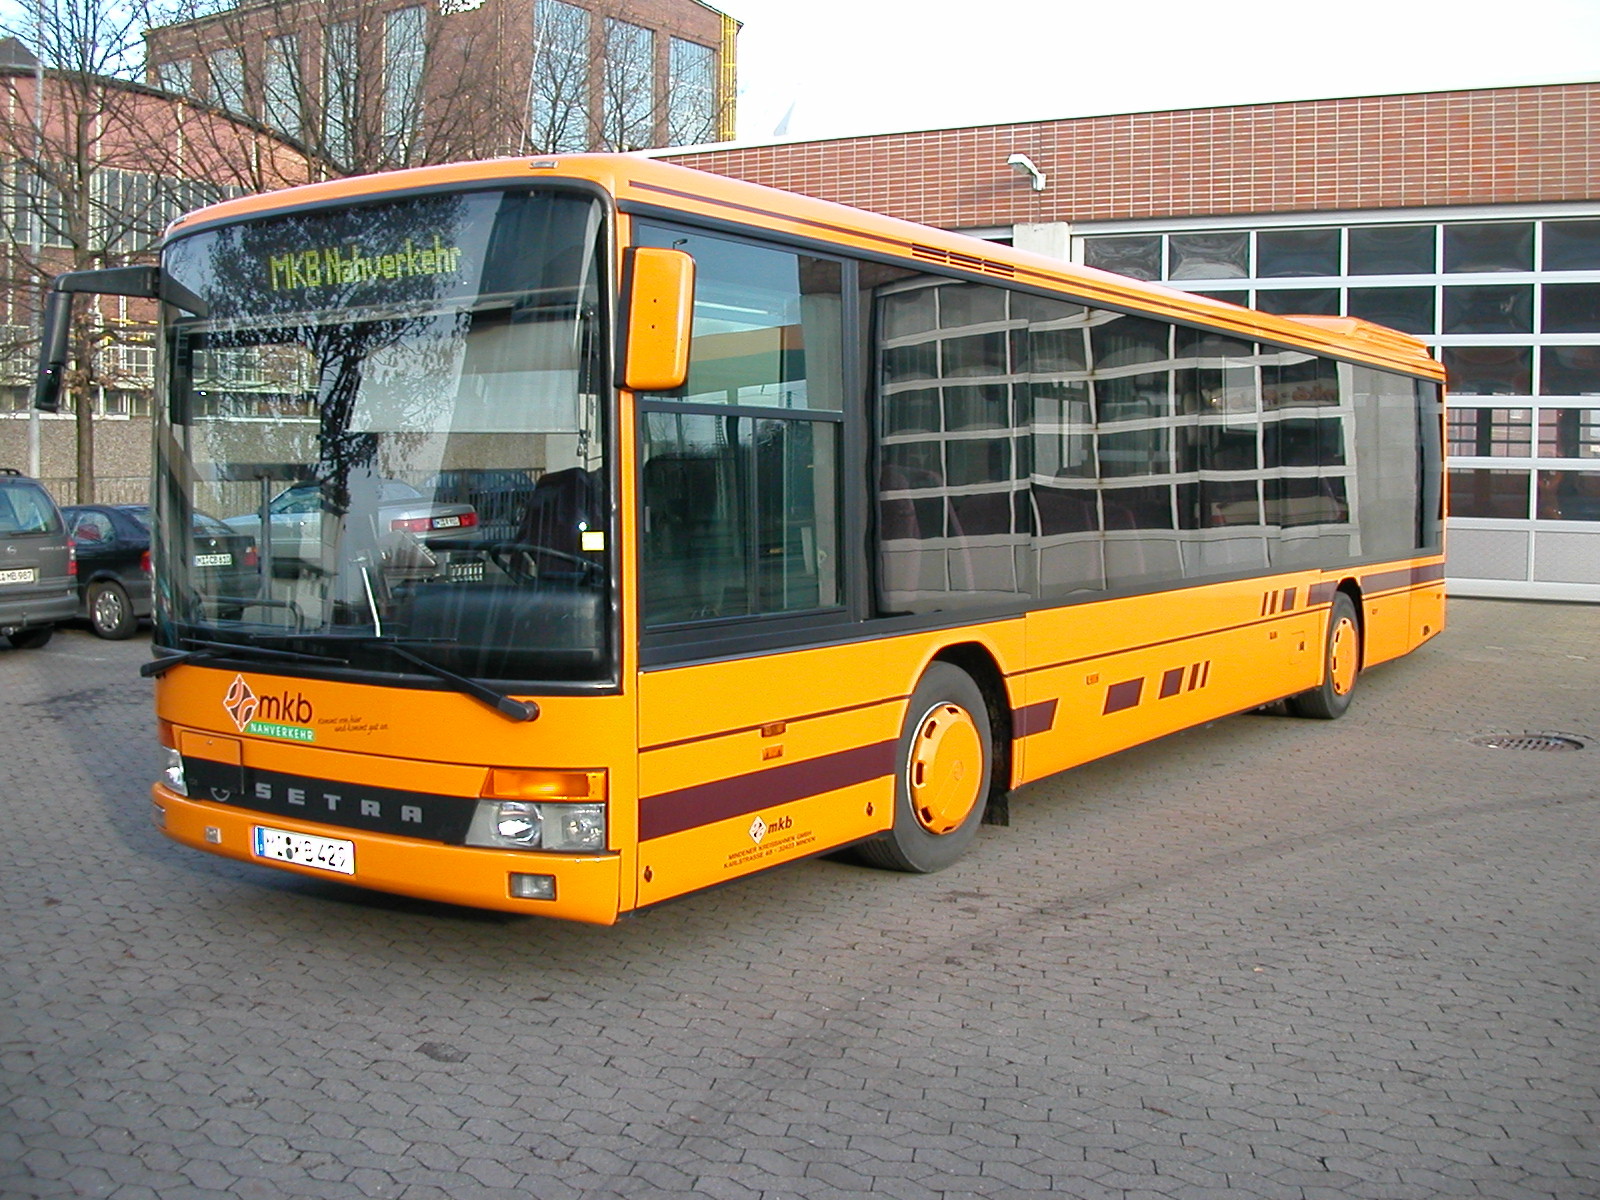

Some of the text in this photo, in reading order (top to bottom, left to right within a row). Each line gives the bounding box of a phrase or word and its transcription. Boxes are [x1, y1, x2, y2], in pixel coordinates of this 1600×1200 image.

[270, 235, 461, 291] MKB Nahverkehr
[258, 691, 313, 724] mkb
[250, 722, 315, 741] NAHVERKEHR
[255, 782, 423, 823] SETRA
[768, 816, 793, 834] mkb
